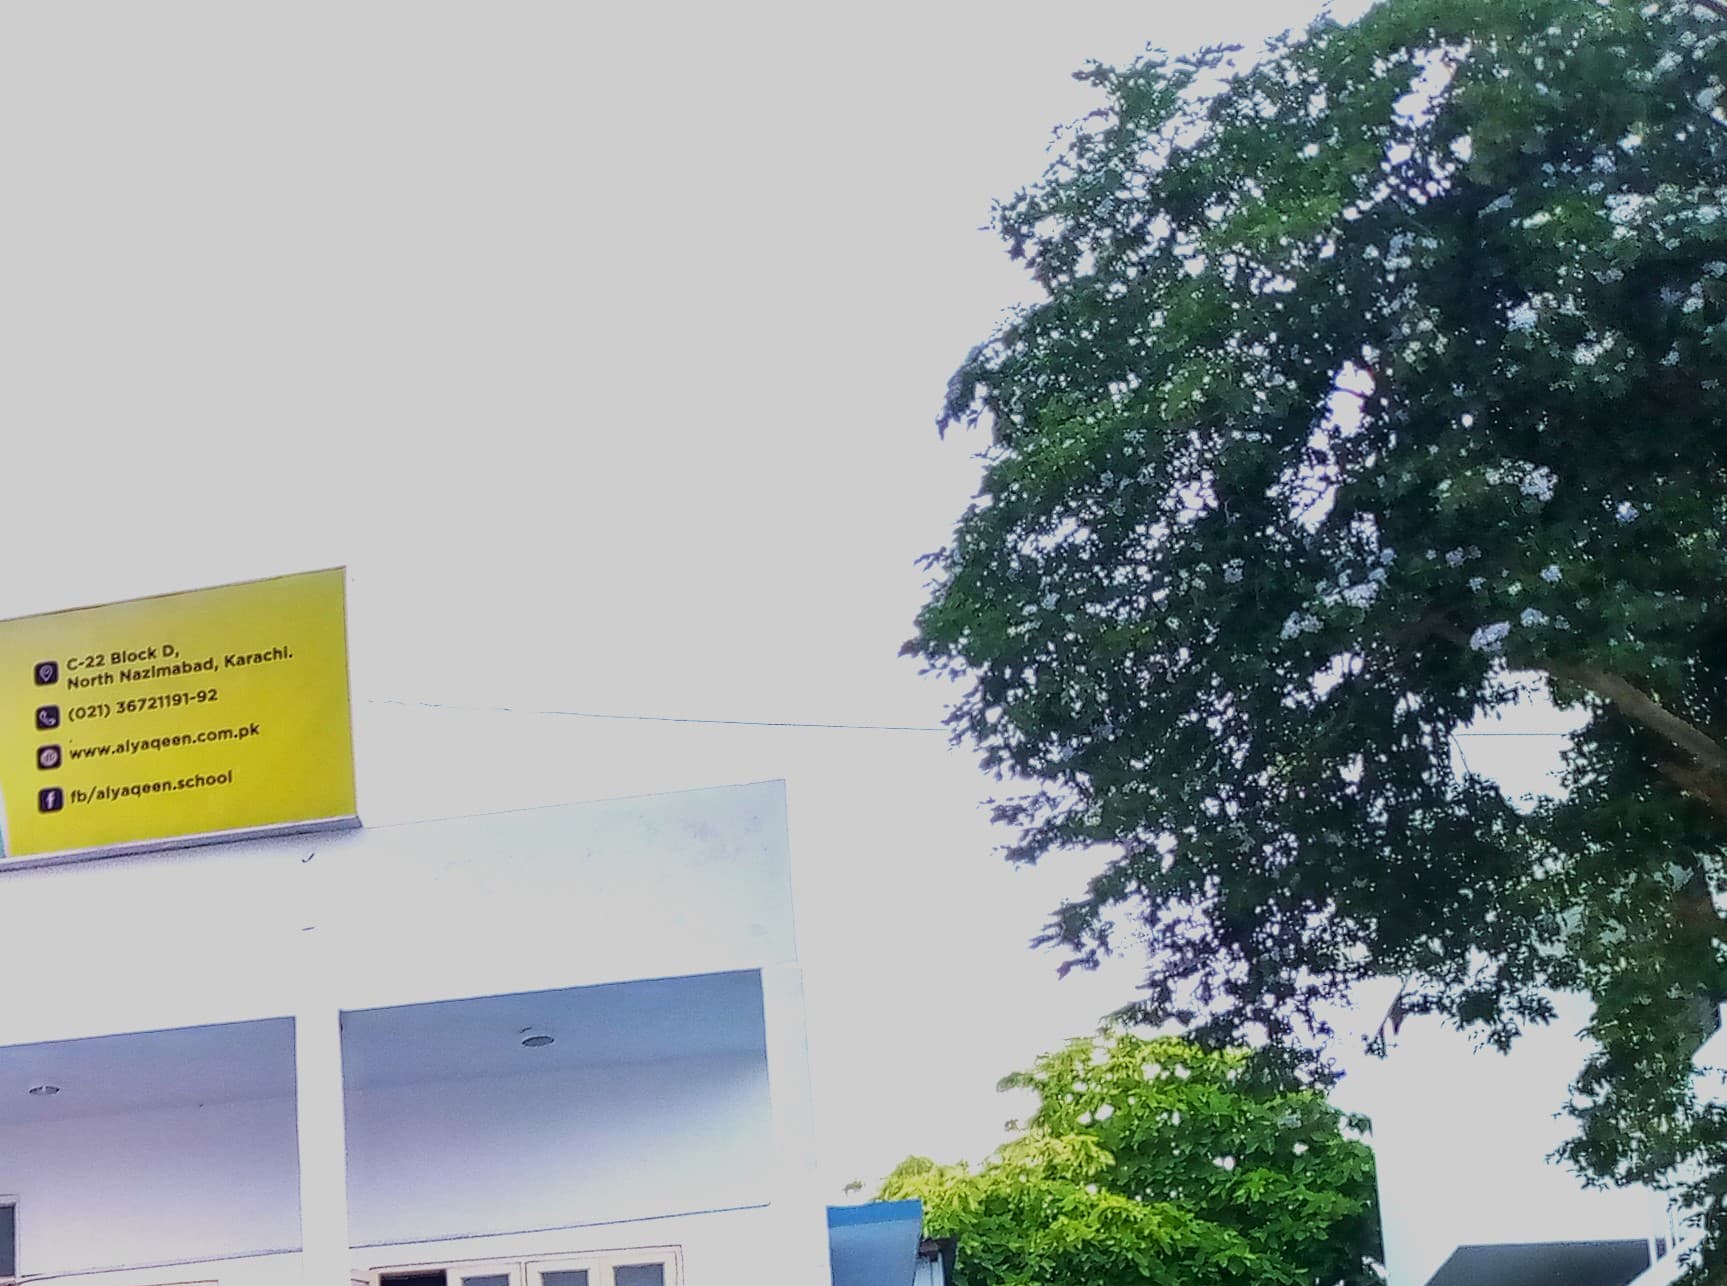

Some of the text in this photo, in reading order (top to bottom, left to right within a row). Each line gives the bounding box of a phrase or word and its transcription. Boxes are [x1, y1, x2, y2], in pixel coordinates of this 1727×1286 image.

[66, 644, 180, 671] C-22 Block D,
[67, 645, 293, 690] North Nazimabad, Karachi.
[68, 688, 218, 722] (021) 36721191-92
[69, 723, 260, 761] www.alyaqeen.com.pk
[70, 770, 233, 804] fb/alyaqeen.school
